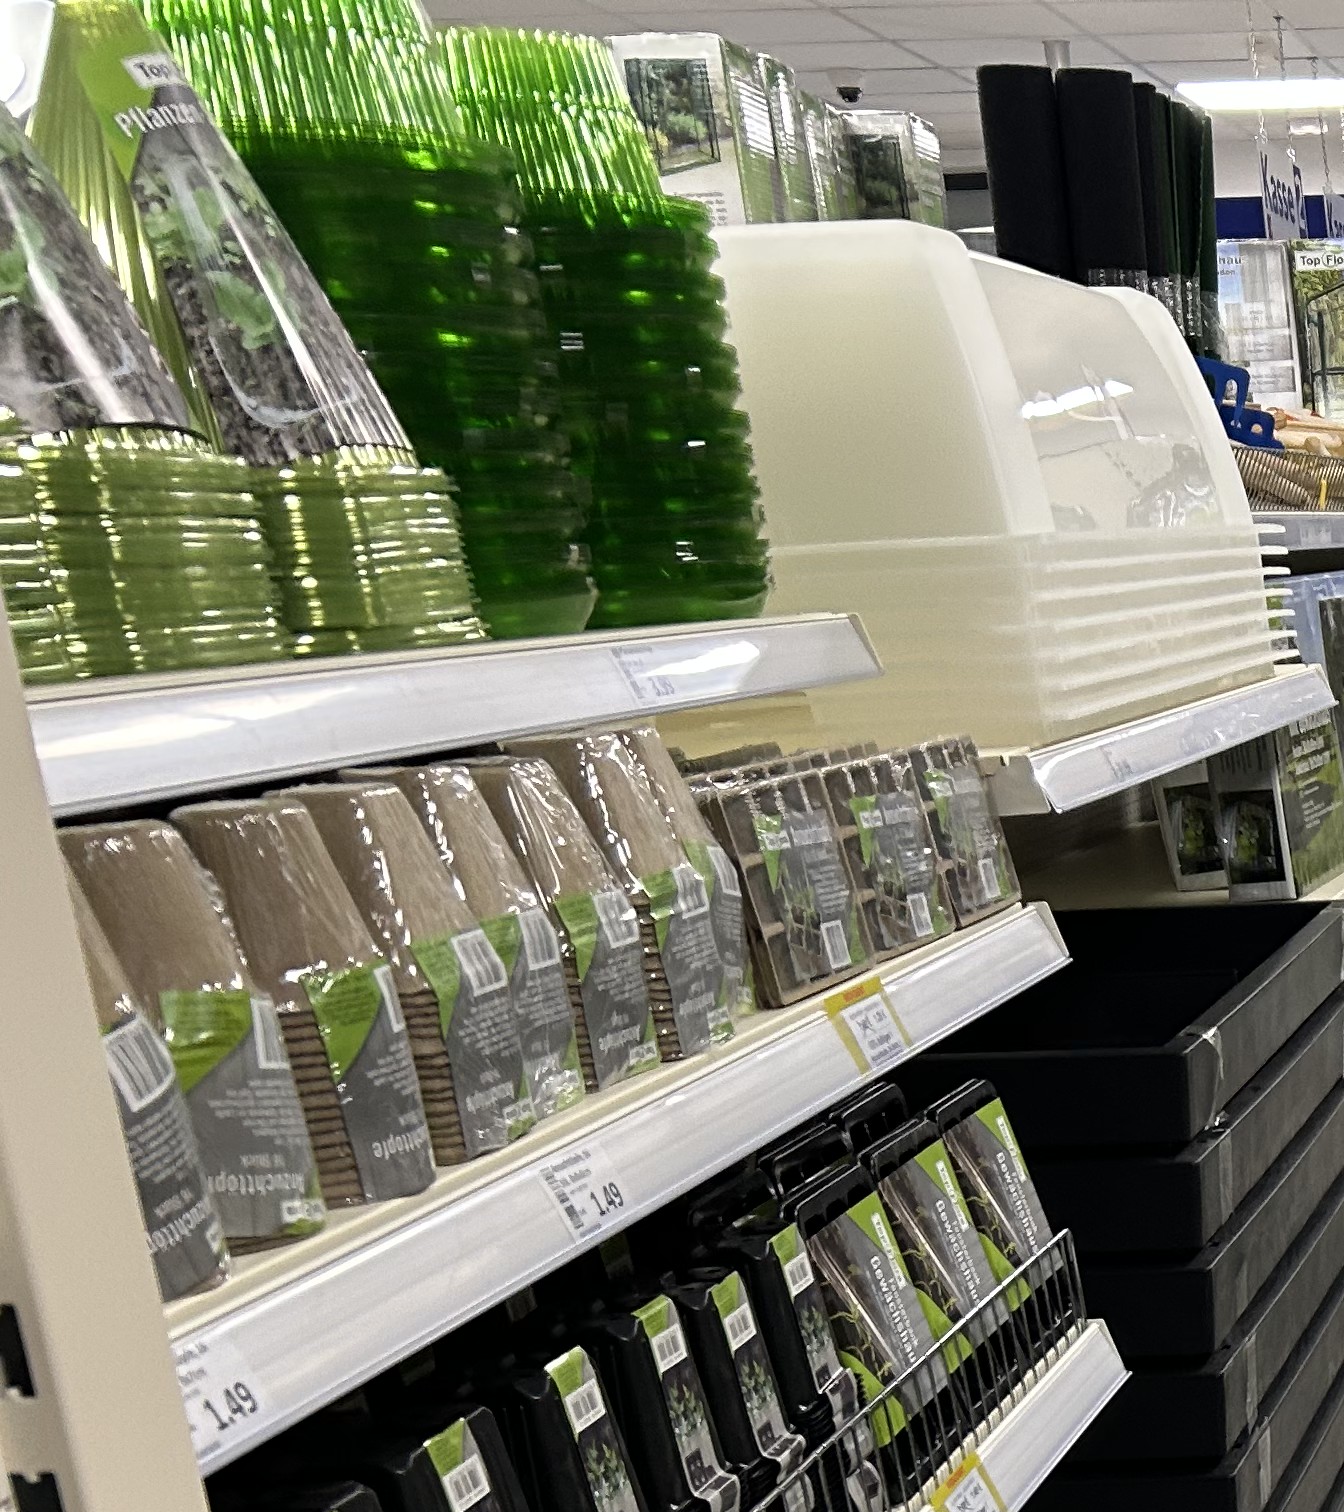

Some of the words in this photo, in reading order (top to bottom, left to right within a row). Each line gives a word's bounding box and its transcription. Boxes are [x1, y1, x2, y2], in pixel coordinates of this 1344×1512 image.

[1260, 151, 1296, 224] Kasse
[1300, 255, 1320, 267] Top
[589, 1182, 623, 1216] 1.49
[871, 1255, 917, 1364] Gewächshau
[203, 1381, 258, 1432] 1.49
